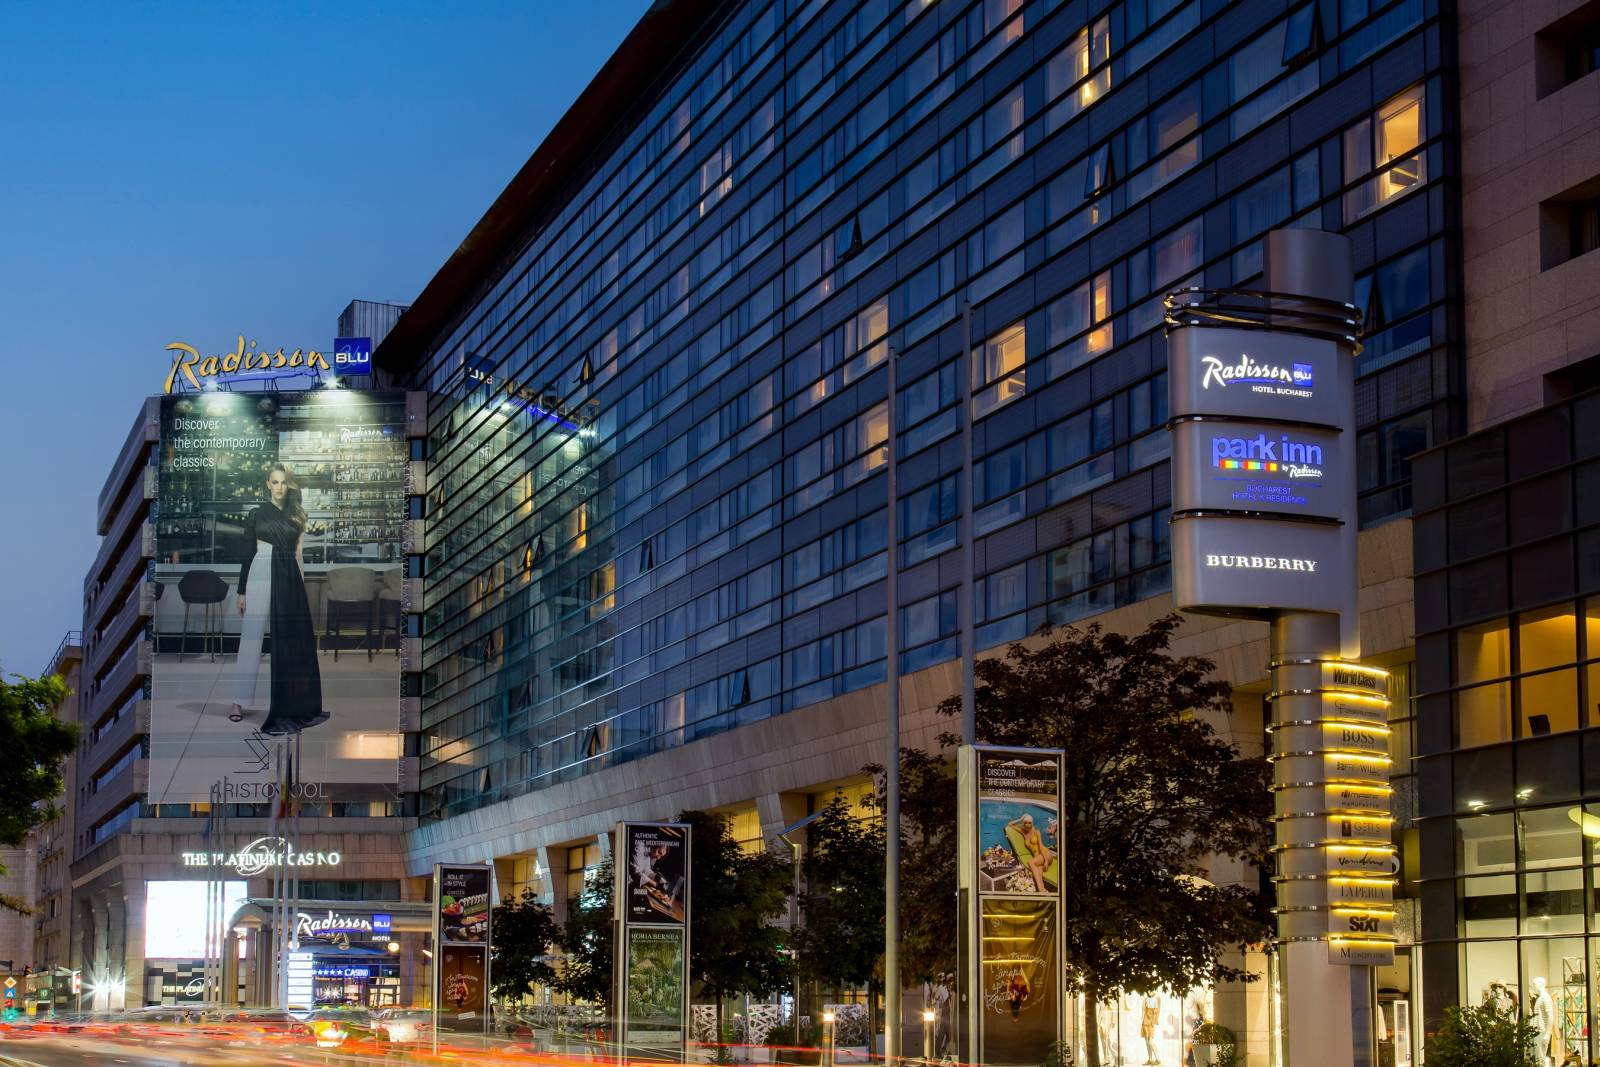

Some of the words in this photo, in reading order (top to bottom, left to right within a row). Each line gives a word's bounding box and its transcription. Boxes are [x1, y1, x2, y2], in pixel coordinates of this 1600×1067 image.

[163, 335, 330, 395] Radisson
[335, 352, 369, 363] BLU
[1201, 354, 1292, 389] Radisson
[1277, 388, 1313, 398] BUCHAREST
[174, 418, 219, 430] Discover
[174, 436, 191, 449] the
[193, 437, 266, 452] contemporary
[1212, 432, 1278, 467] park
[1281, 434, 1323, 465] inn
[173, 456, 215, 468] classics
[1281, 464, 1289, 473] by
[1289, 464, 1323, 477] Radisson
[1206, 554, 1318, 572] BURBERRY
[1333, 669, 1357, 685] World
[1358, 673, 1376, 689] Class
[1342, 729, 1375, 745] BOSS
[987, 768, 1016, 778] DISCOVER
[211, 783, 329, 799] ARISTOOOL
[182, 852, 209, 866] THE
[287, 852, 340, 866] CASNO
[296, 910, 373, 937] Radisson
[344, 968, 369, 977] CASINO
